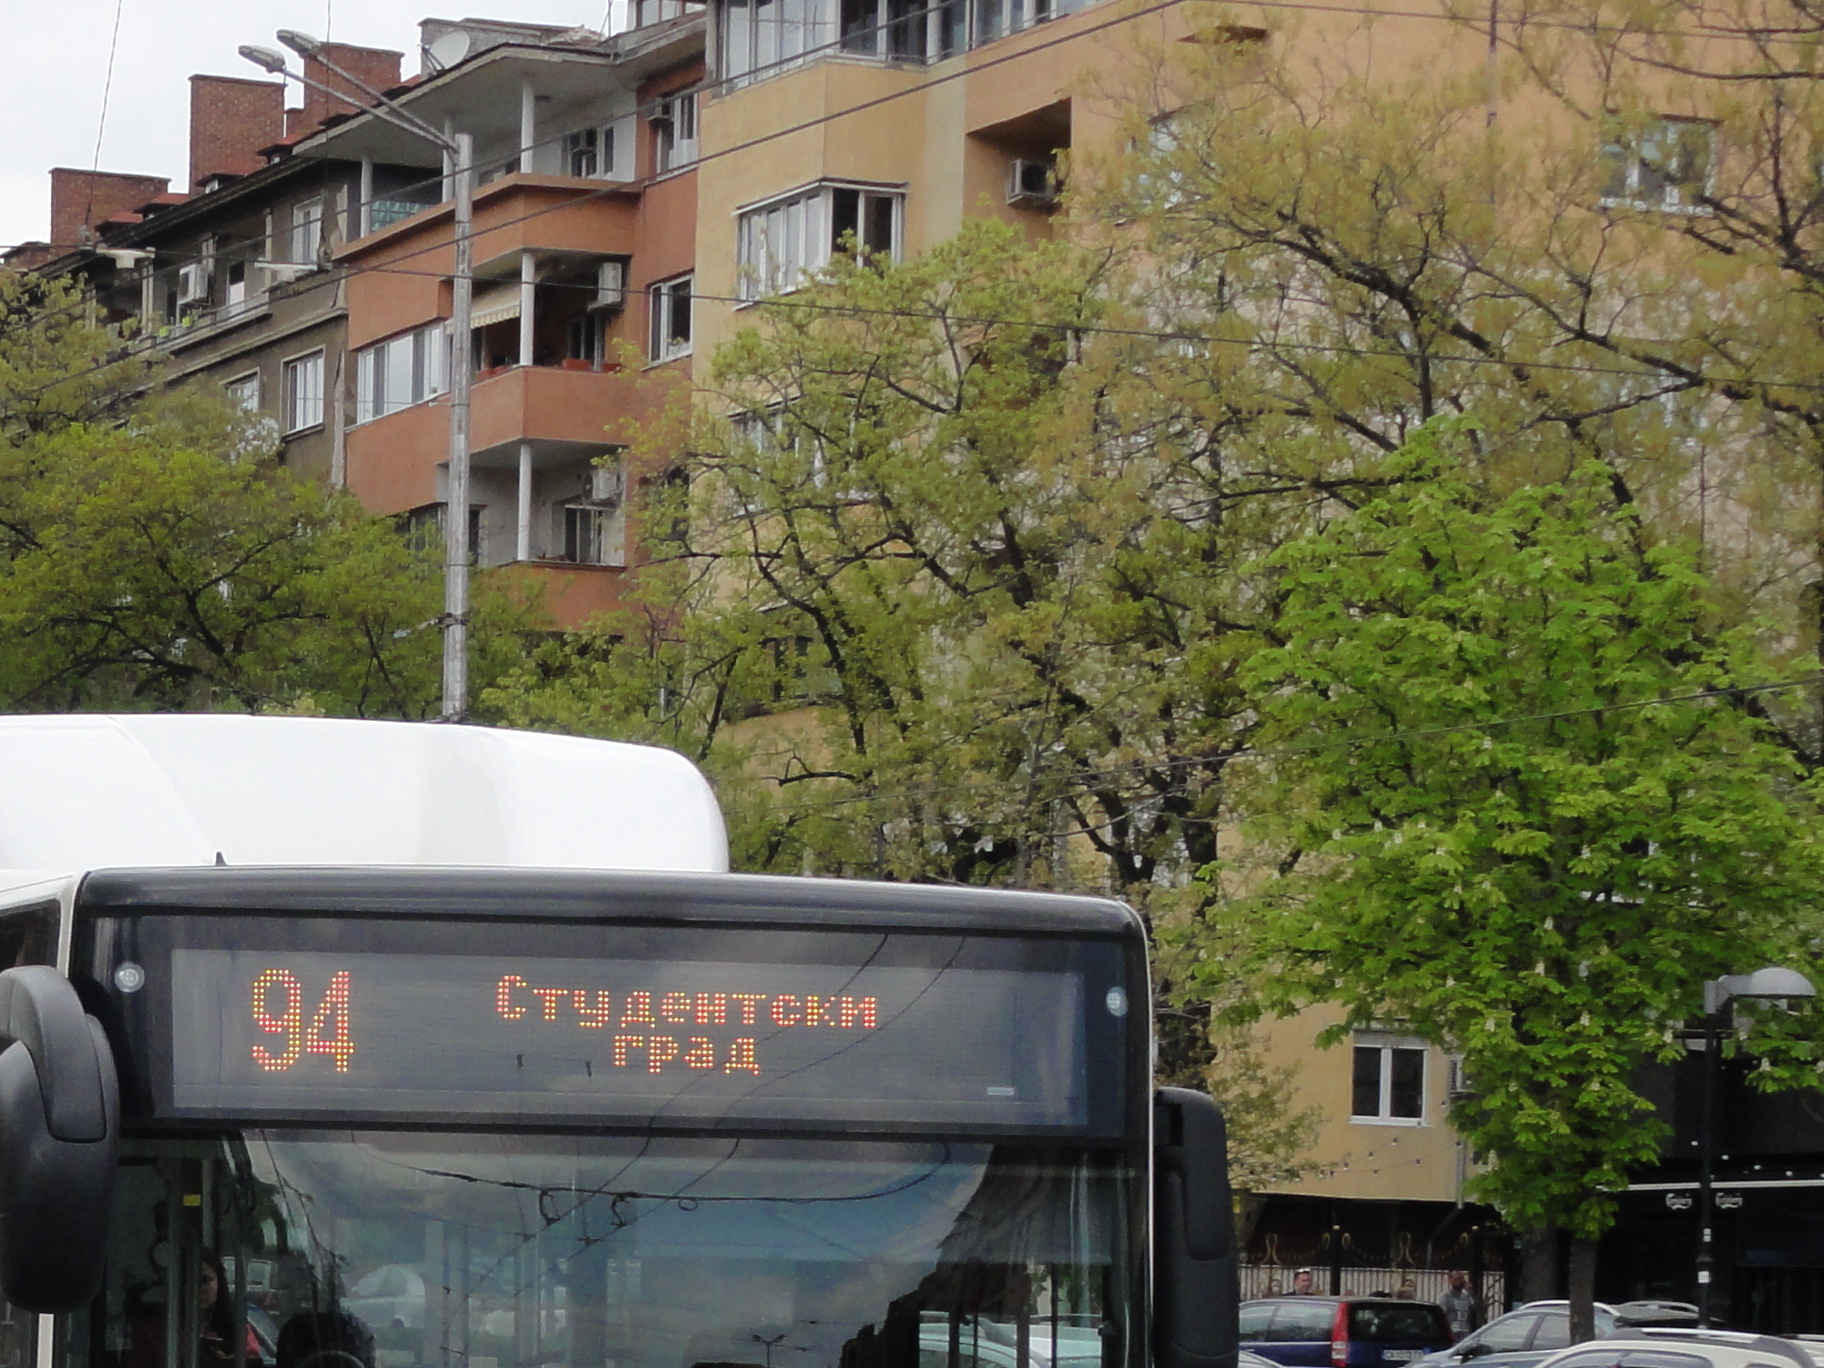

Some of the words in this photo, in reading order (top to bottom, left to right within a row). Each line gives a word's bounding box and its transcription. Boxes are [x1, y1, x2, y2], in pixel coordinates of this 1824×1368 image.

[253, 969, 354, 1071] 94
[497, 975, 877, 1028] Студентски
[614, 1035, 759, 1075] град
